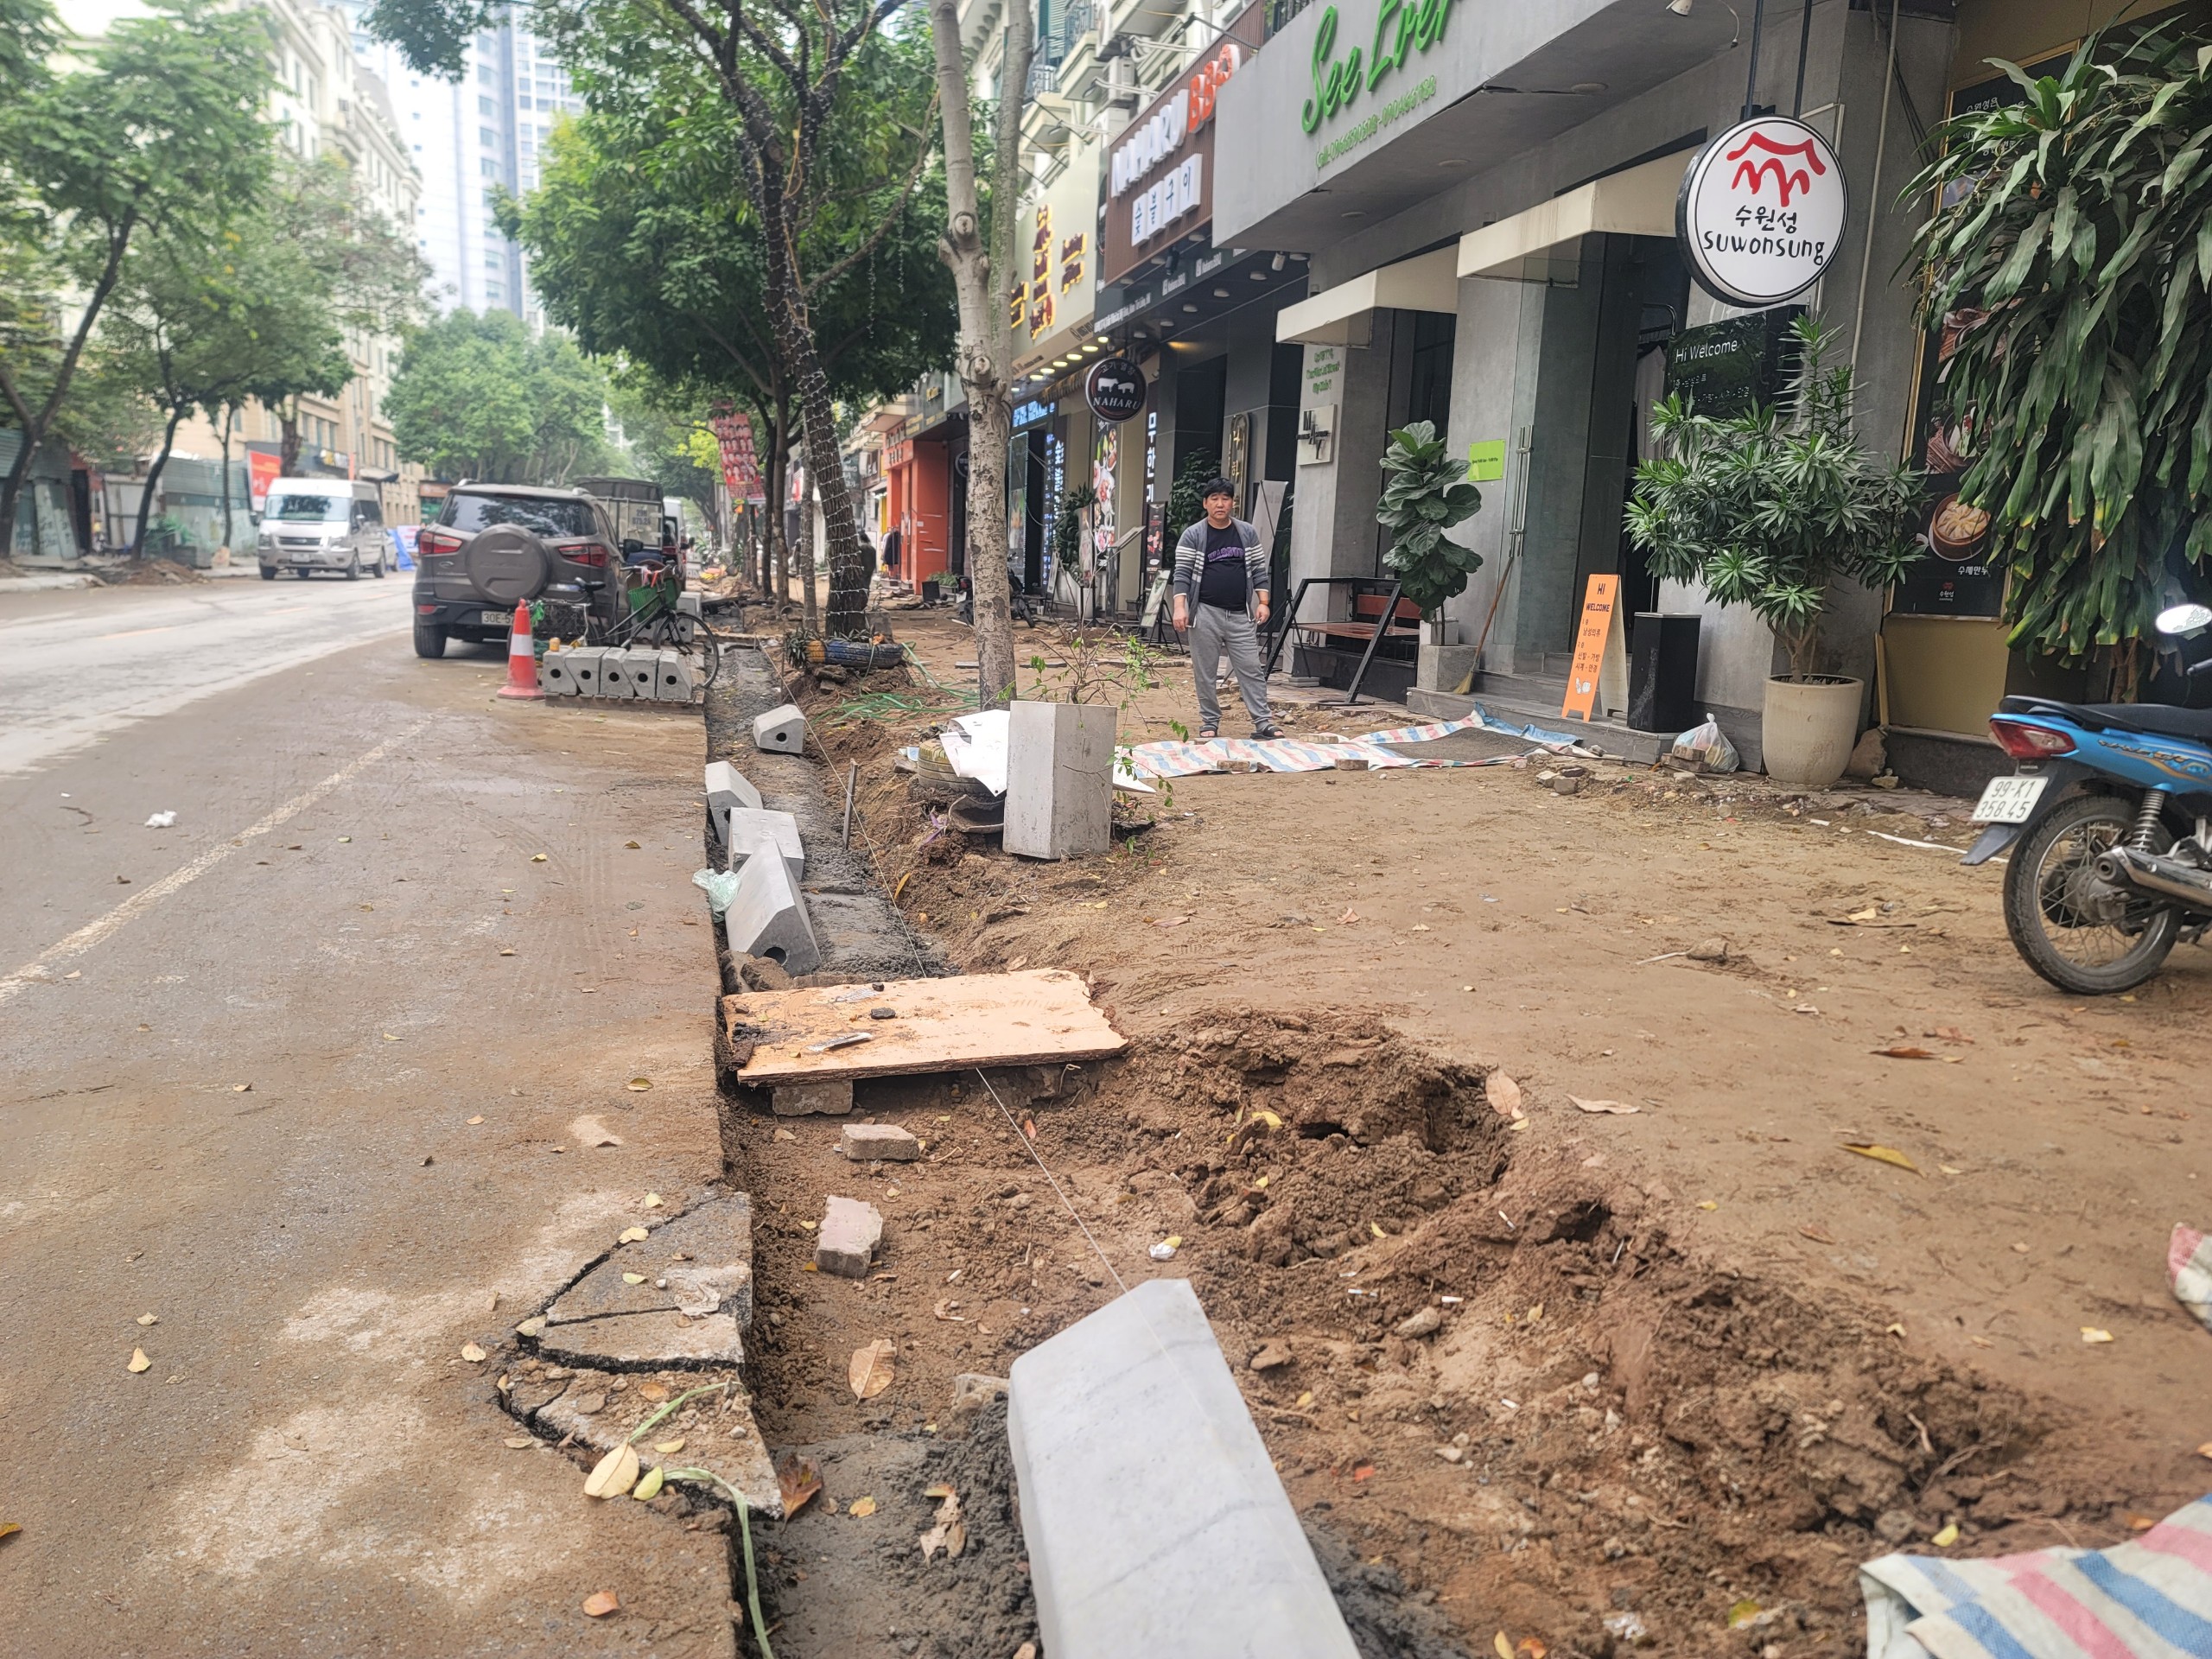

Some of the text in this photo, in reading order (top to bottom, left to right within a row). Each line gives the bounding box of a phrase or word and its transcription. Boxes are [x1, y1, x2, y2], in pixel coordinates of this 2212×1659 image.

[1301, 4, 1363, 132] See
[1111, 89, 1189, 198] NAHARU
[1735, 205, 1797, 234] 수원성
[1676, 340, 1738, 363] Hi Welcome
[1093, 397, 1141, 410] NAHARU
[1597, 583, 1605, 594] HI
[1586, 603, 1610, 612] WELCOME
[1992, 781, 2036, 798] 99-K1
[1977, 801, 2031, 818] 358.45
